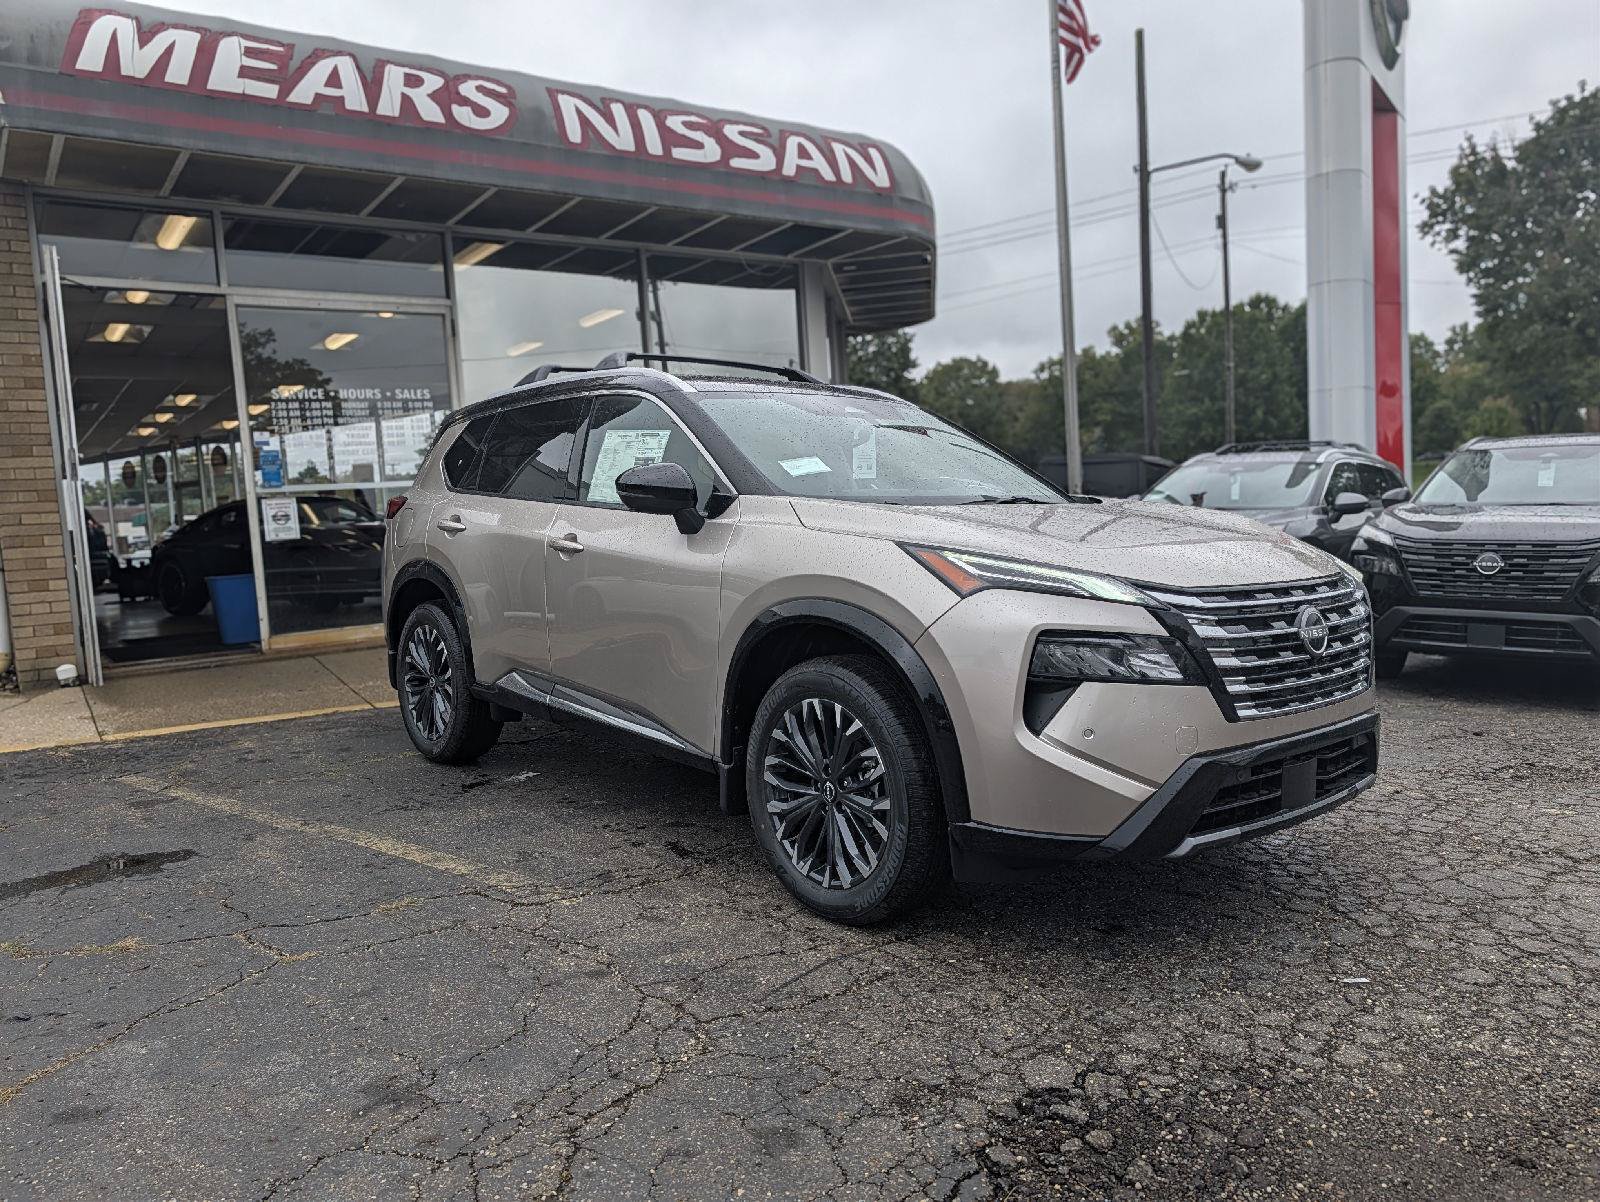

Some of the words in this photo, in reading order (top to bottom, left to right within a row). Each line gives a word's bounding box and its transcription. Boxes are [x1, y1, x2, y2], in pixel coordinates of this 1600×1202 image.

[75, 14, 511, 131] MEARS
[557, 92, 890, 188] NISSAN
[338, 388, 382, 400] HOURS
[395, 388, 431, 400] SALES
